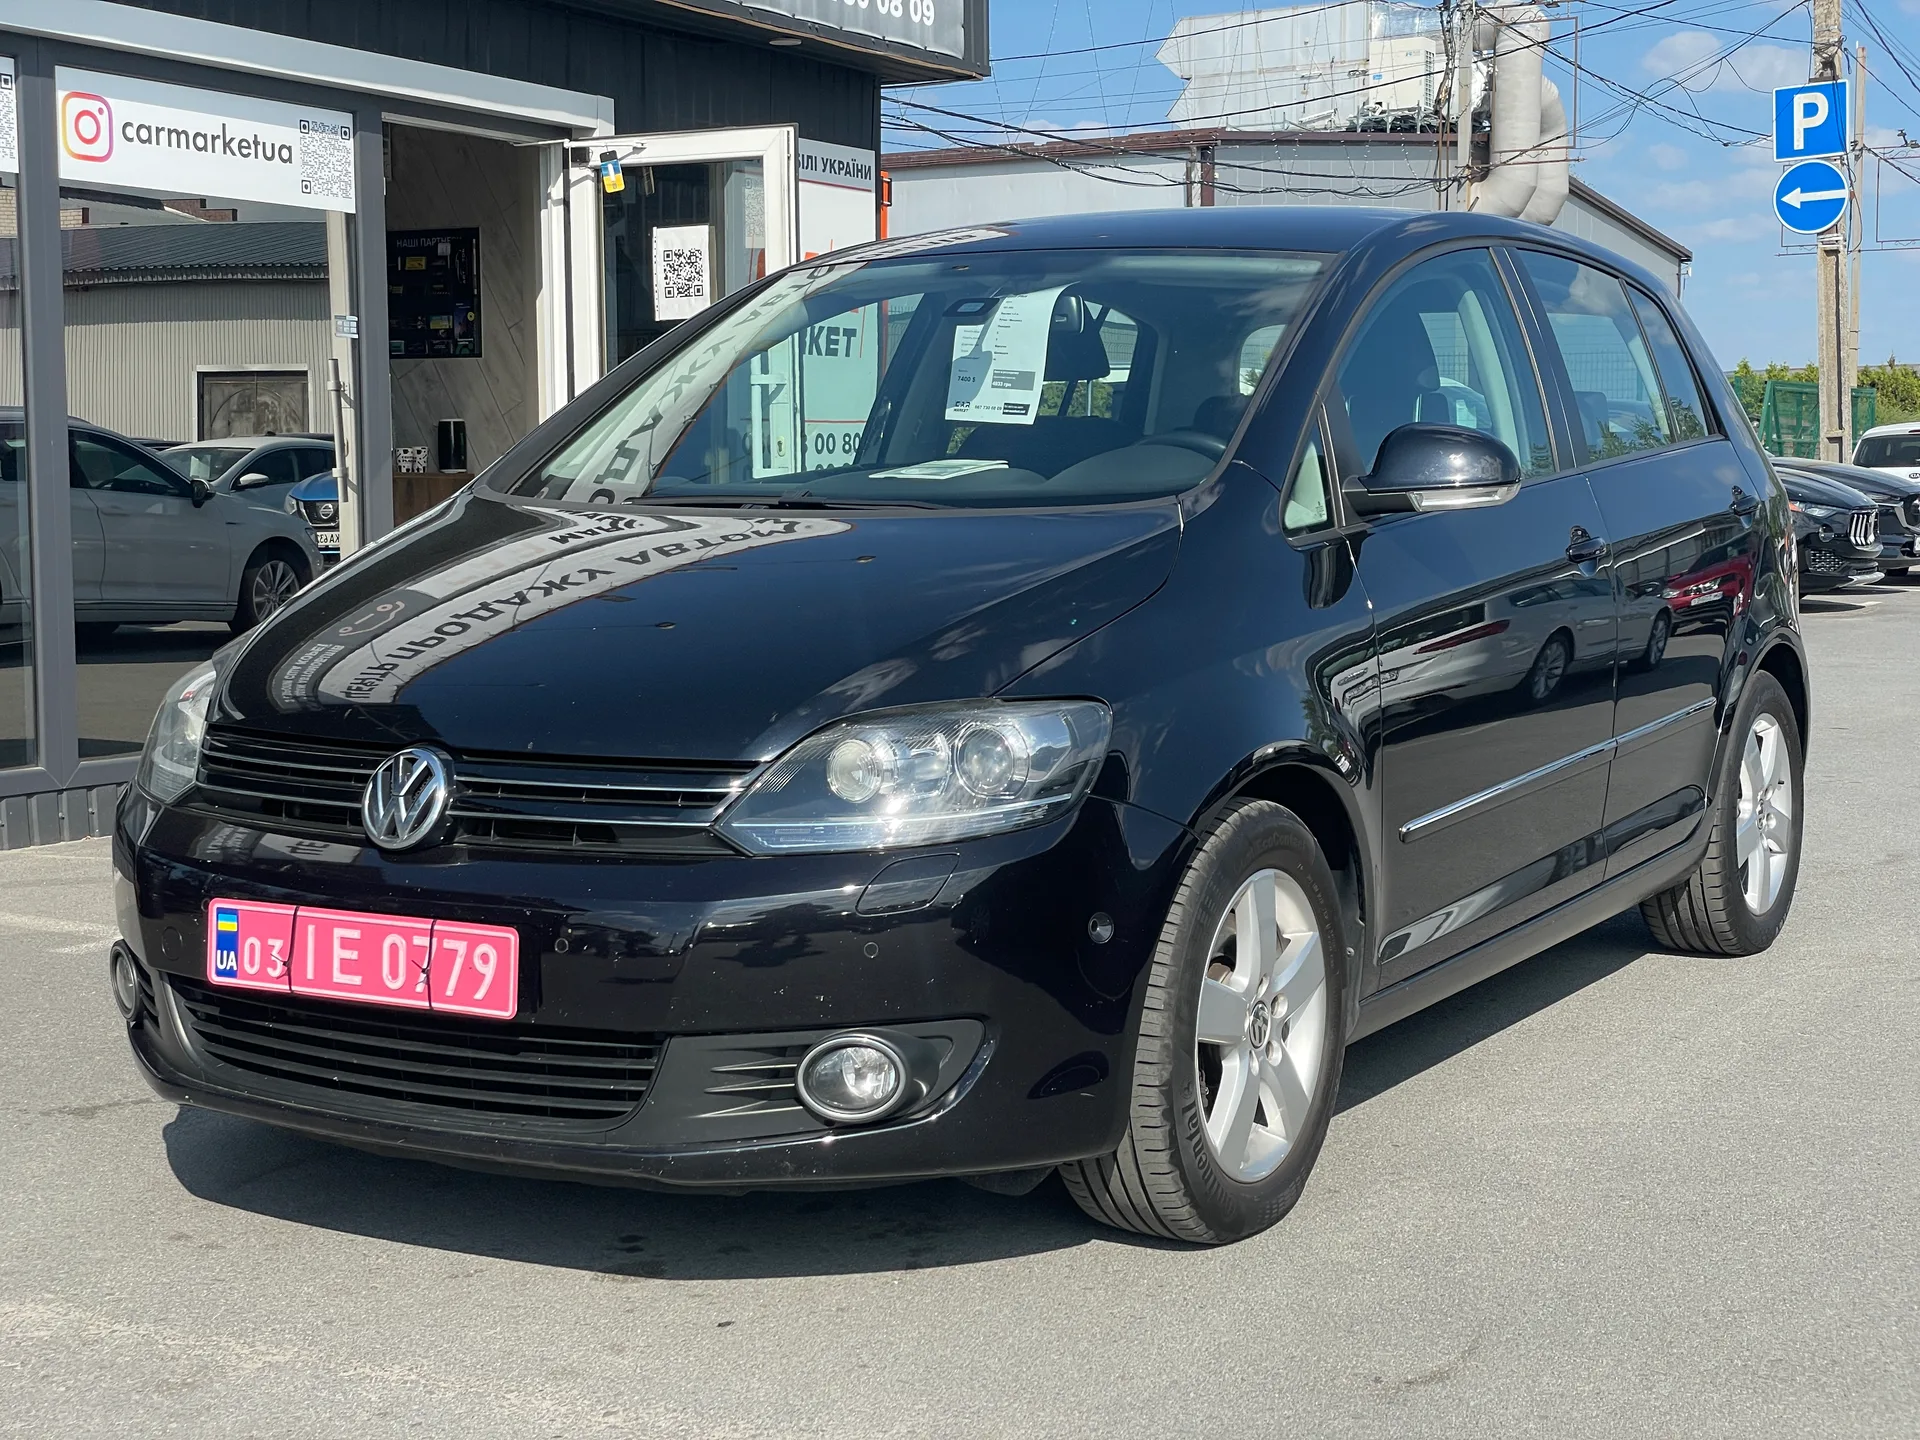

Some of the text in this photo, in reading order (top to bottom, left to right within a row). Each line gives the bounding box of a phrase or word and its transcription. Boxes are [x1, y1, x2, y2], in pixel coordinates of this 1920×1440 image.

[909, 0, 935, 26] 09
[1792, 91, 1829, 150] P
[121, 122, 293, 165] carmarketua
[821, 157, 872, 181] УКРАЇНИ
[396, 236, 462, 248] НАШІ ПАРТНЕ
[803, 325, 858, 358] KET
[815, 433, 836, 455] 00
[216, 950, 238, 971] UA
[243, 924, 499, 1001] 03 IE 0779
